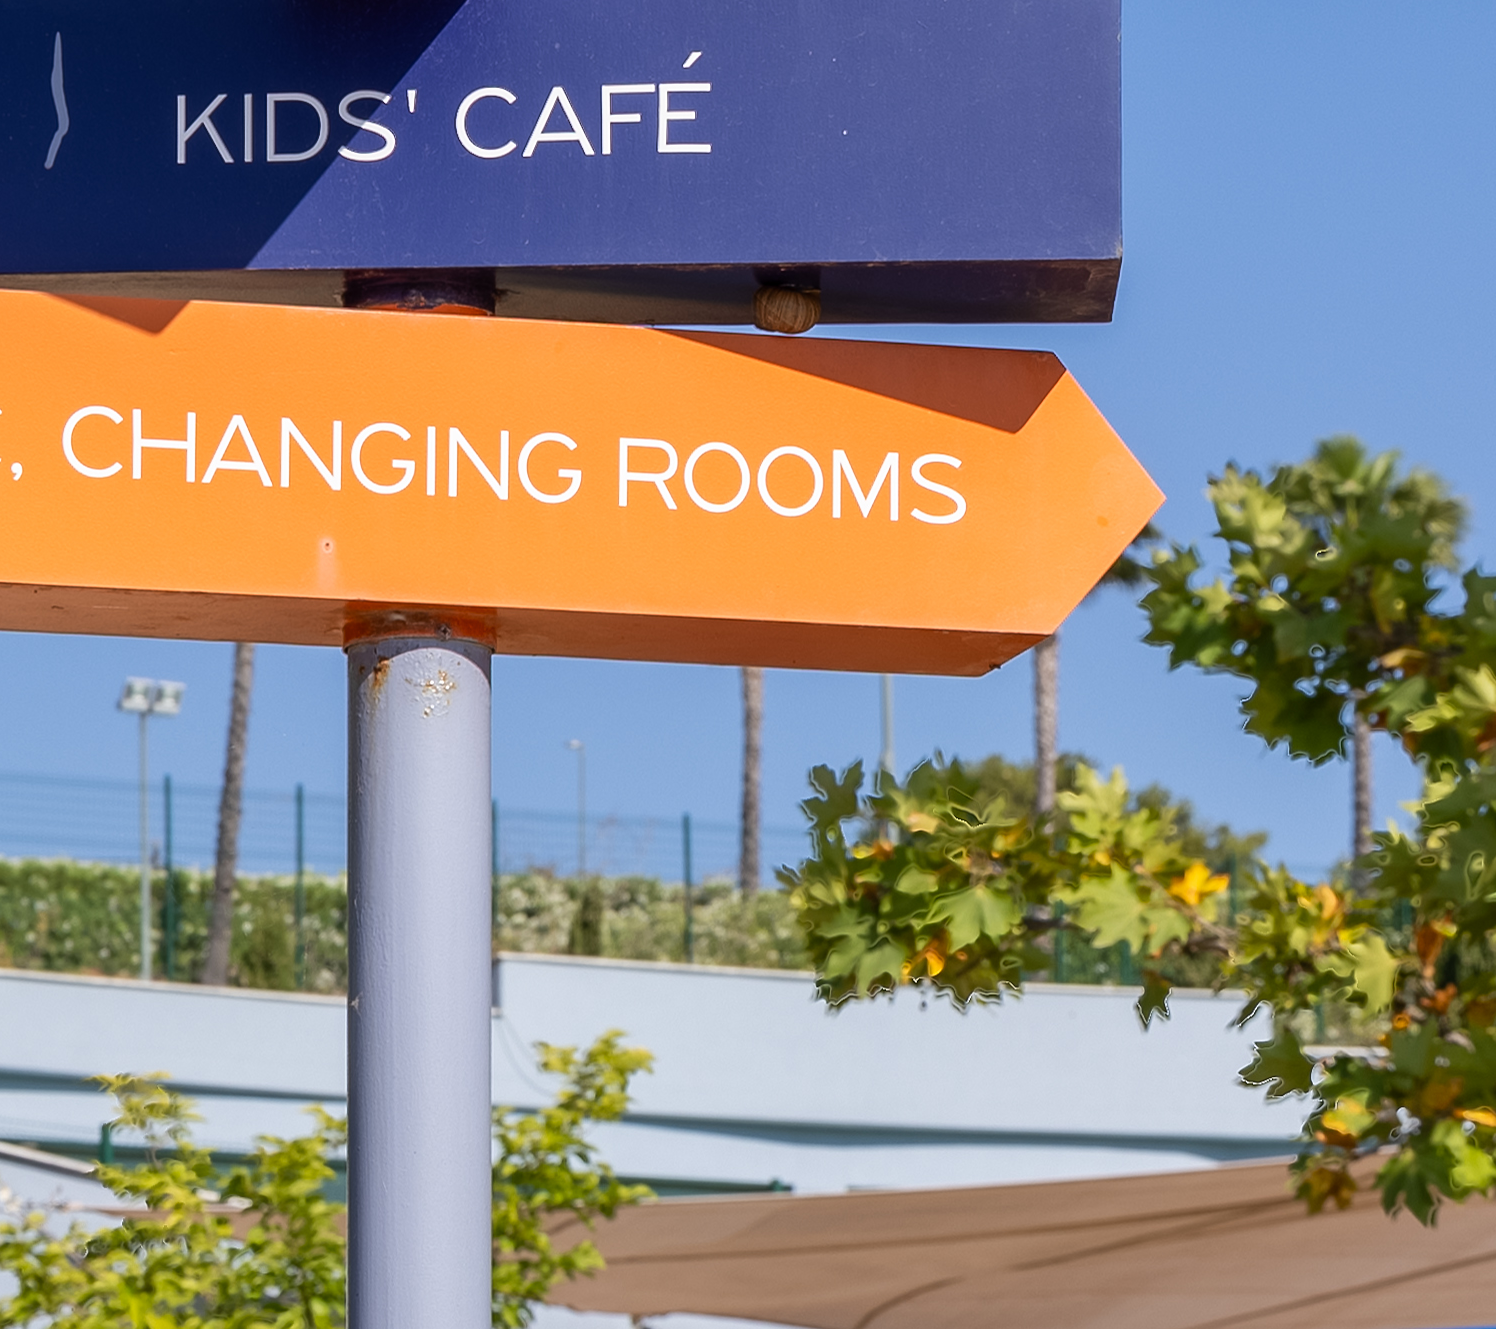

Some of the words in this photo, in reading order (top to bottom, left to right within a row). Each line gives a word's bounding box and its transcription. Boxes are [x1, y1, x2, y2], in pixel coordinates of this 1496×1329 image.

[176, 88, 417, 165] KIDS'
[454, 51, 712, 160] CAFÉ
[62, 405, 582, 504] CHANGING
[618, 437, 967, 525] ROOMS
